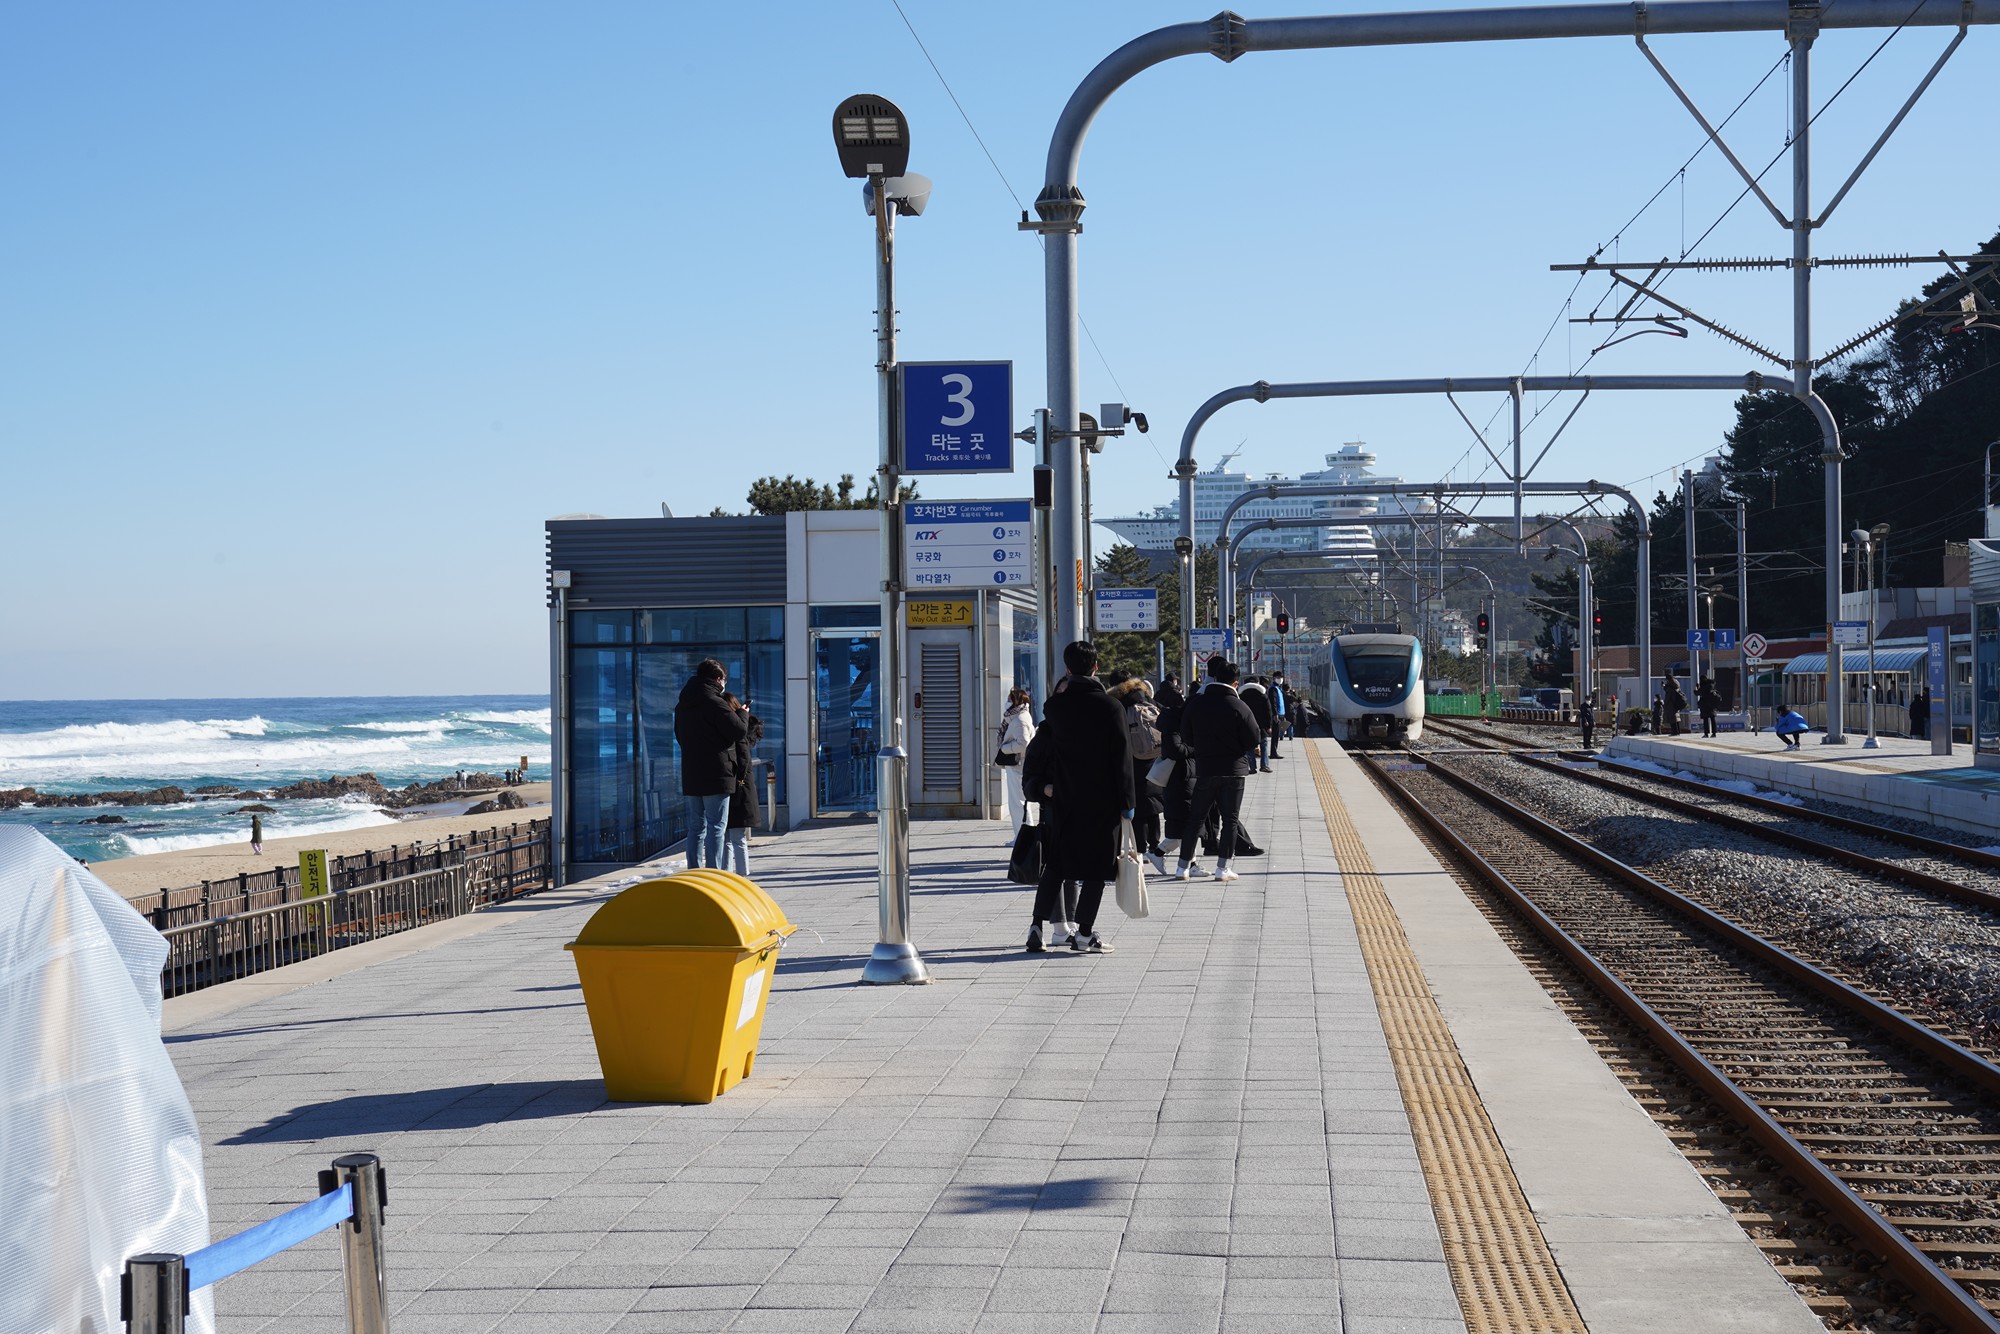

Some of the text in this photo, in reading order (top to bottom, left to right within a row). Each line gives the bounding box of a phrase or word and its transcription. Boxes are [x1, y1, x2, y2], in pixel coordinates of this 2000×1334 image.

[941, 373, 975, 426] 3
[931, 433, 985, 451] 타는 곳
[914, 505, 957, 518] 호차번호
[915, 529, 943, 540] KTX
[995, 528, 1003, 538] 4
[916, 551, 942, 562] 무궁화
[996, 550, 1003, 560] 3
[916, 573, 951, 584] 바다열차
[1009, 573, 1021, 581] 호차
[910, 603, 952, 615] 나가는 곳
[911, 616, 925, 624] Way
[1694, 632, 1702, 643] 2
[1721, 632, 1727, 642] 1
[1750, 640, 1759, 649] A
[306, 853, 320, 906] 안전거
